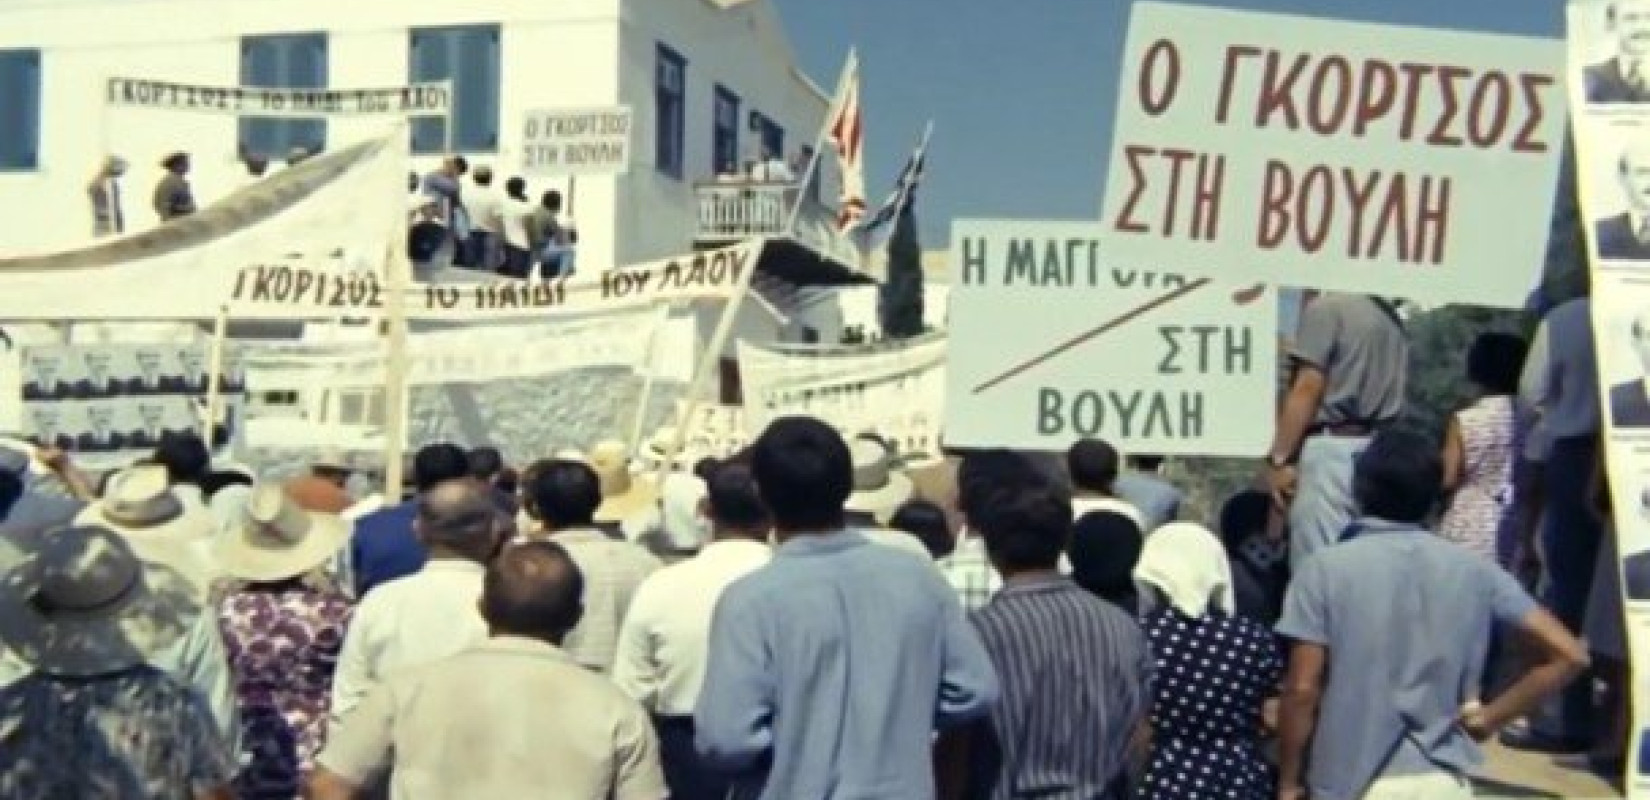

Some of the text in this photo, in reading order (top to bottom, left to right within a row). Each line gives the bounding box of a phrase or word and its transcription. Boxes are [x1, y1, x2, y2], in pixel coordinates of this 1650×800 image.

[1138, 38, 1555, 153] Ο ΓΚΟΡΤΣΟΣ
[1114, 144, 1452, 265] ΣΤΗ ΒΟΥΛΗ
[961, 237, 987, 287] Η
[1157, 326, 1252, 374] ΣΤΗ
[1037, 387, 1203, 439] ΒΟΥΛΗ
